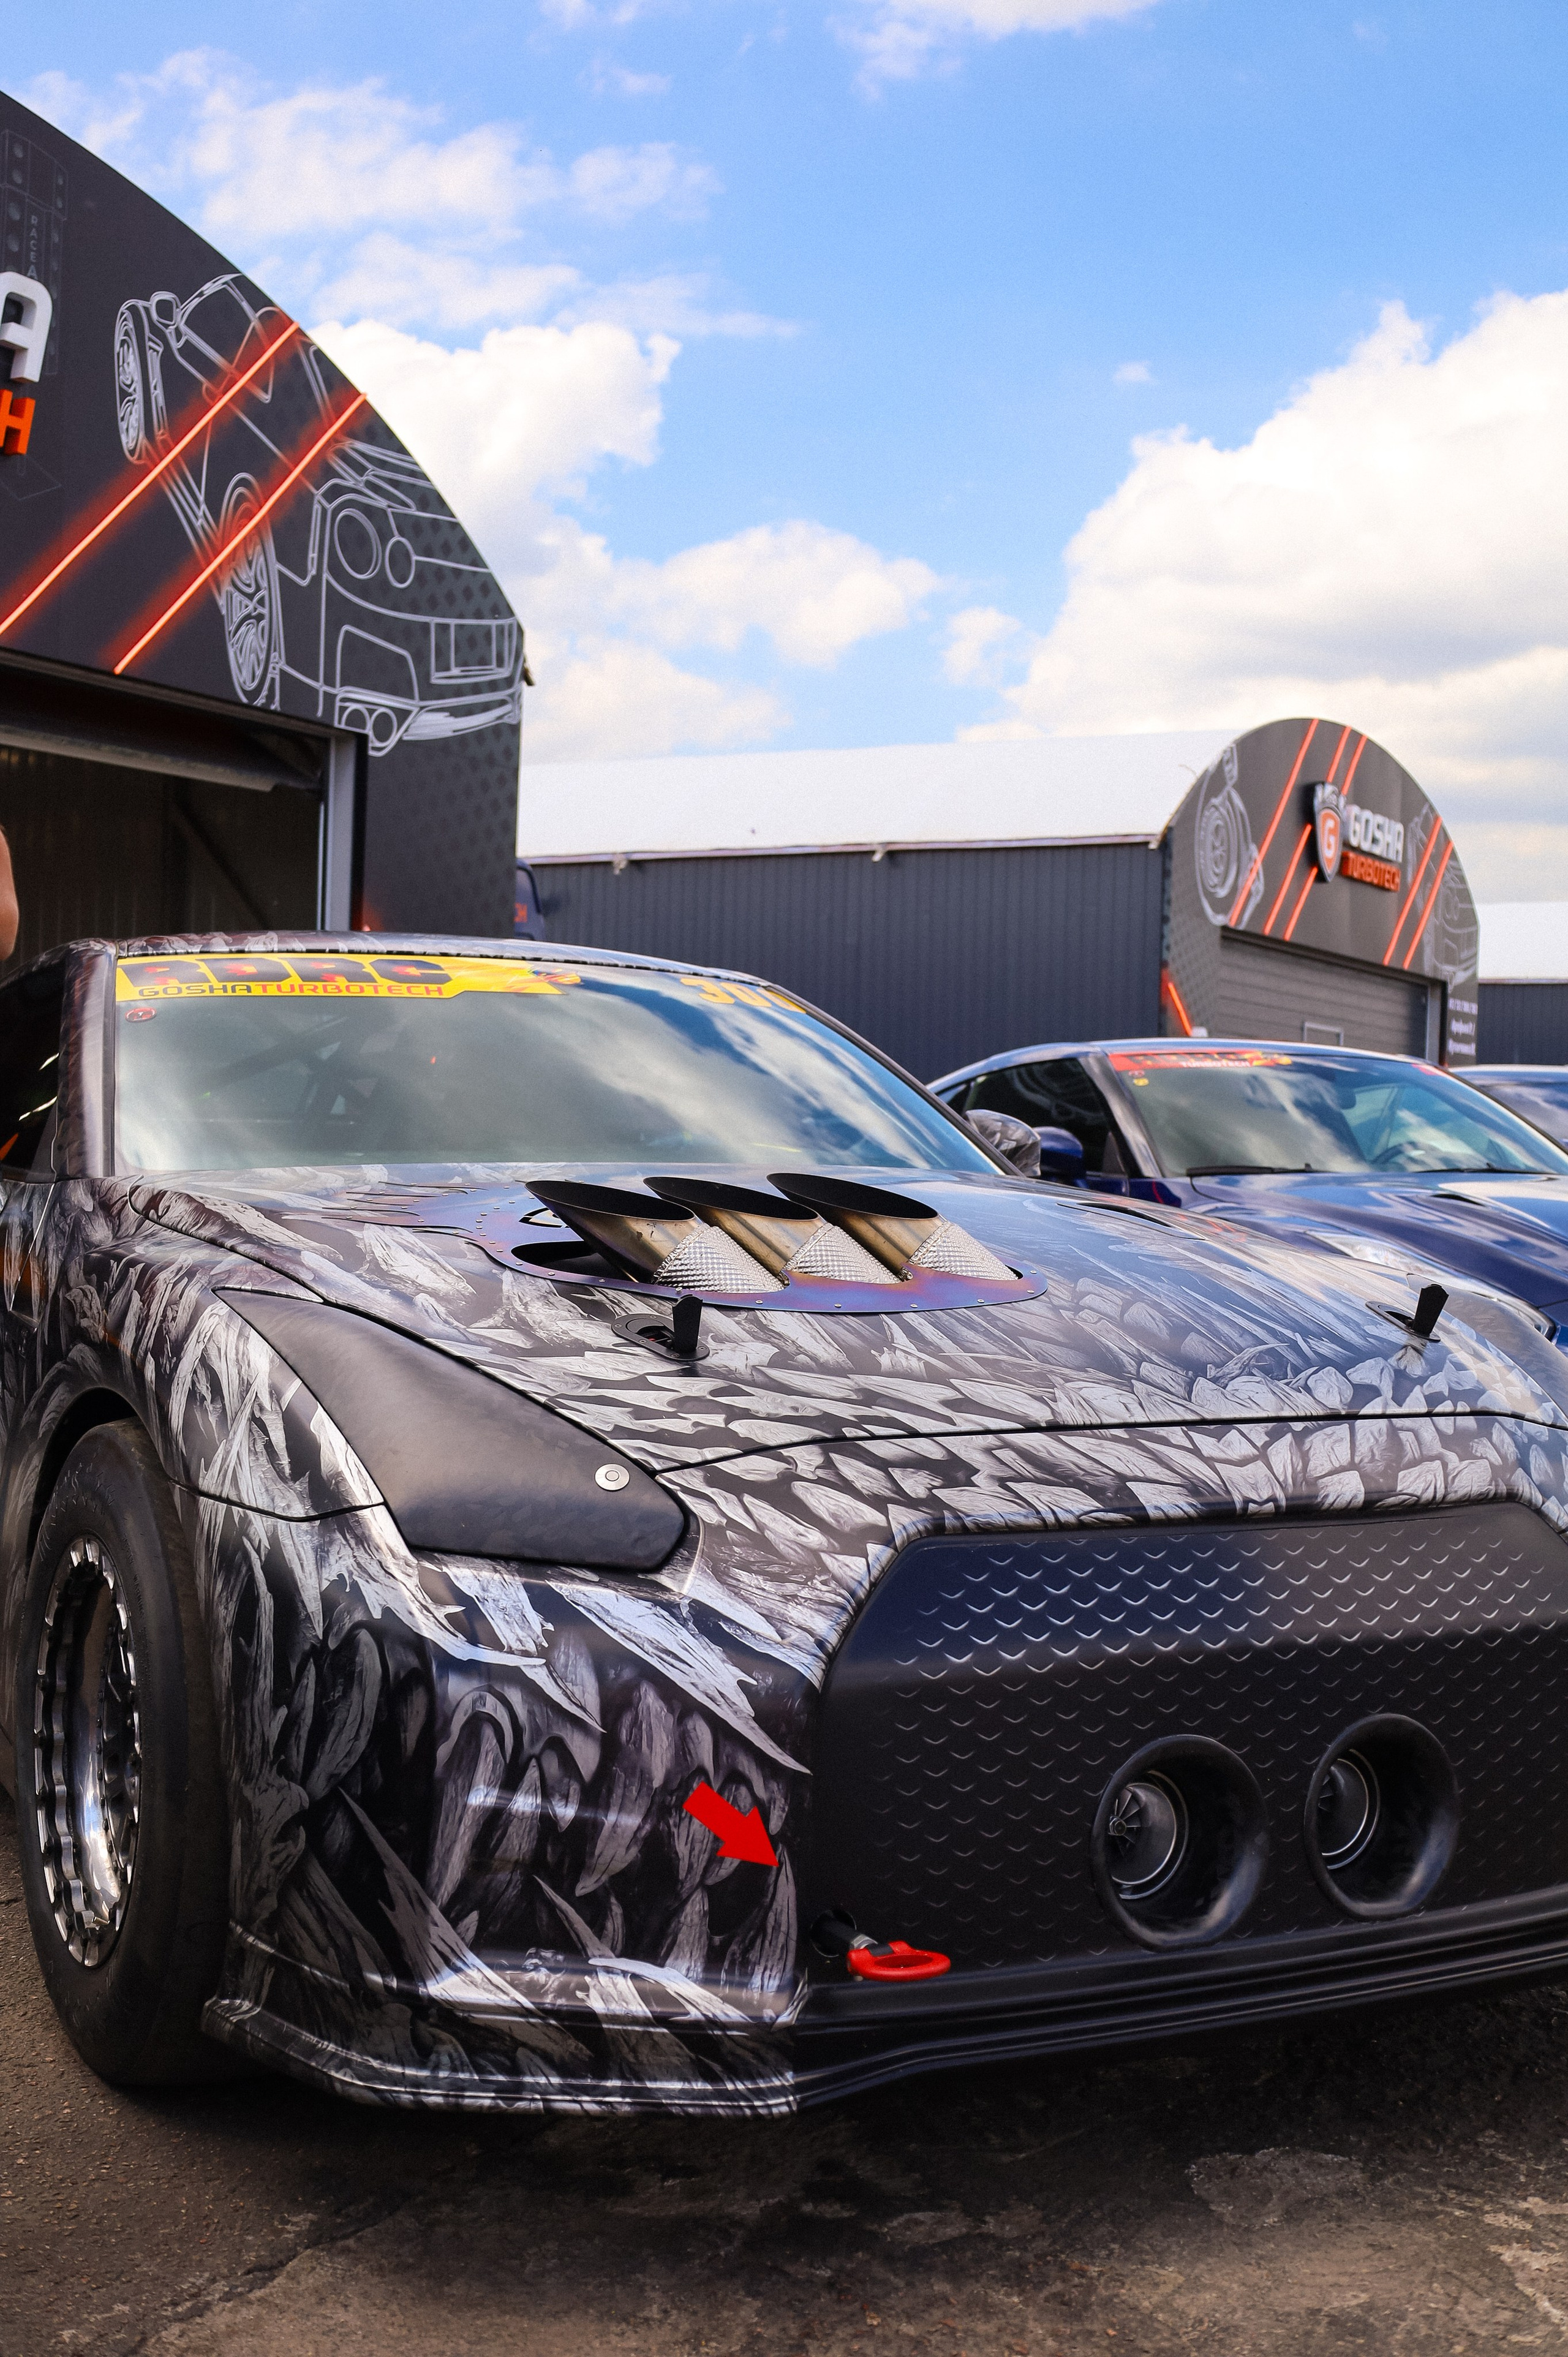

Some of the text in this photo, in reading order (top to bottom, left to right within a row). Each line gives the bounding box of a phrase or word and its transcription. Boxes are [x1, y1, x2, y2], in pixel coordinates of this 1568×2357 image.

[1348, 804, 1404, 863] GOSHA
[1343, 850, 1401, 892] TURBOTECH
[138, 983, 444, 998] GOSHATURBOTECH
